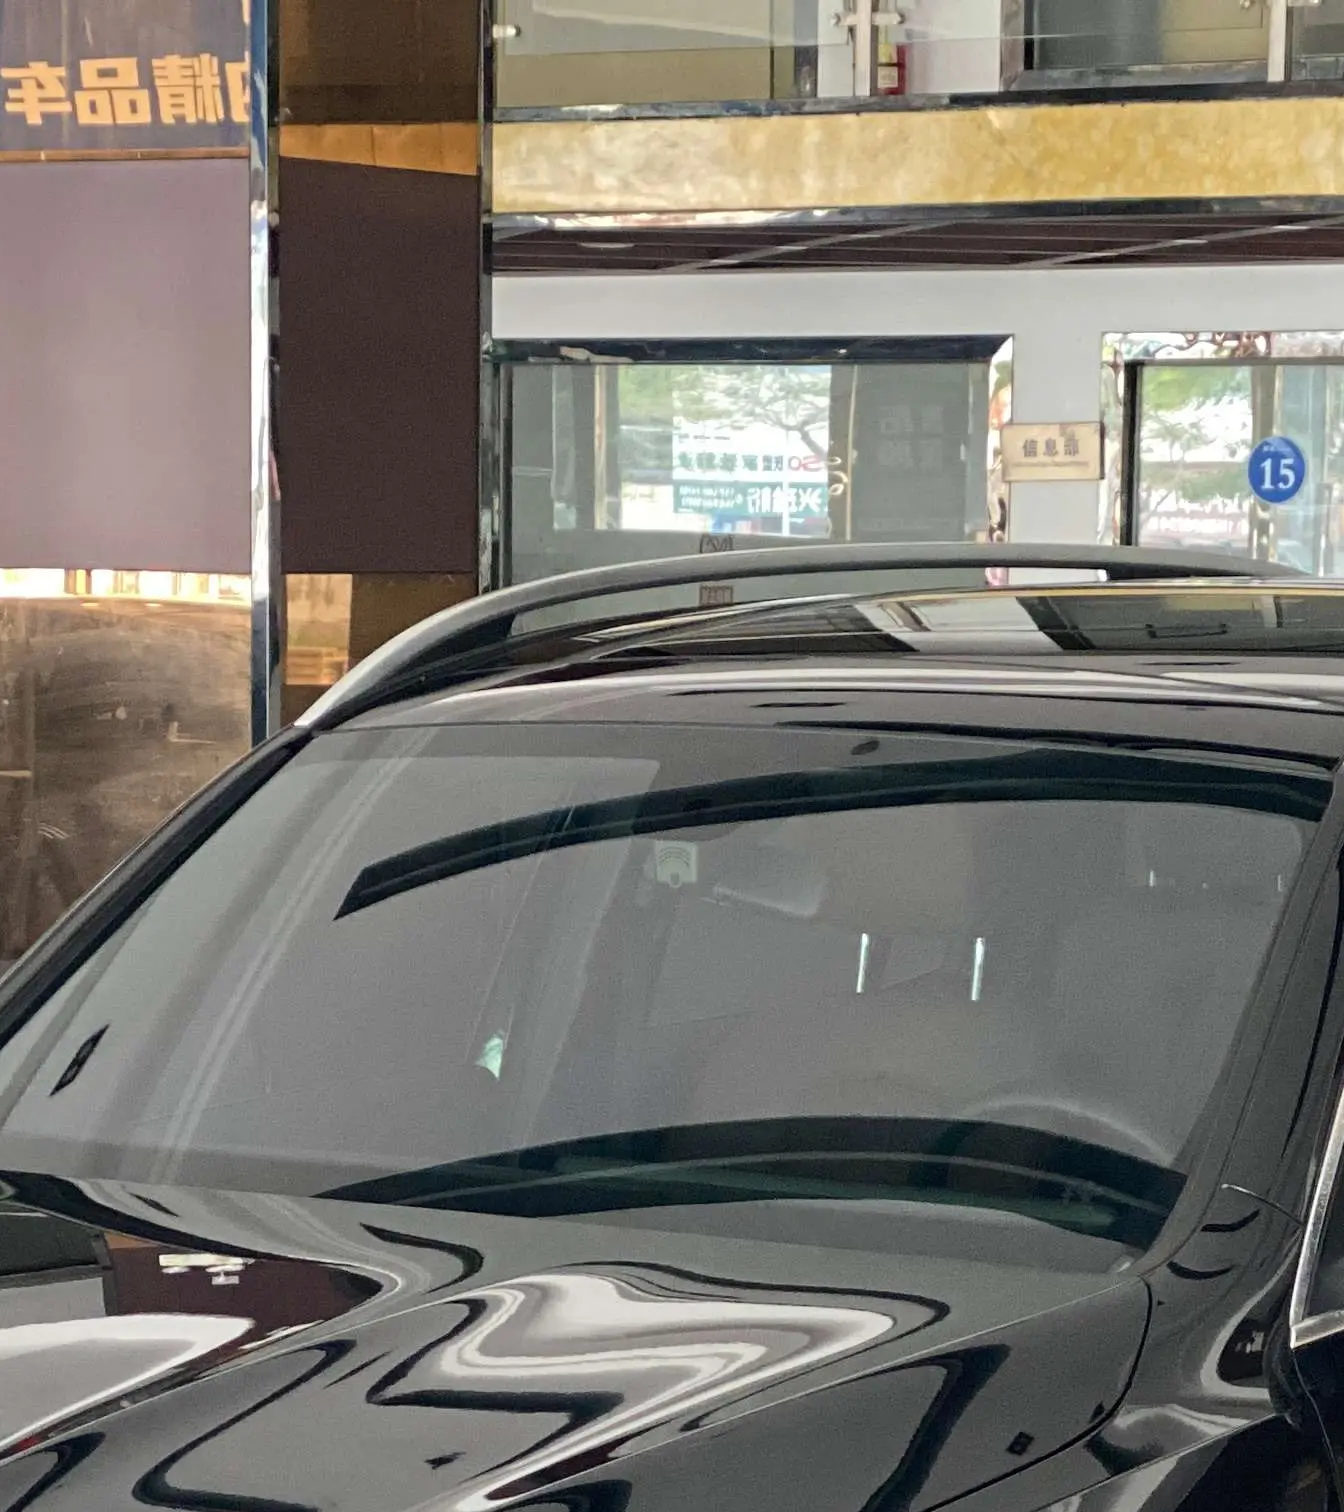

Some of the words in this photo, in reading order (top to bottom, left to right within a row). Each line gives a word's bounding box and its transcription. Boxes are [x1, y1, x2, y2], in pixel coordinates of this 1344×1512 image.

[1022, 437, 1080, 457] 信息部
[1260, 457, 1296, 489] 15
